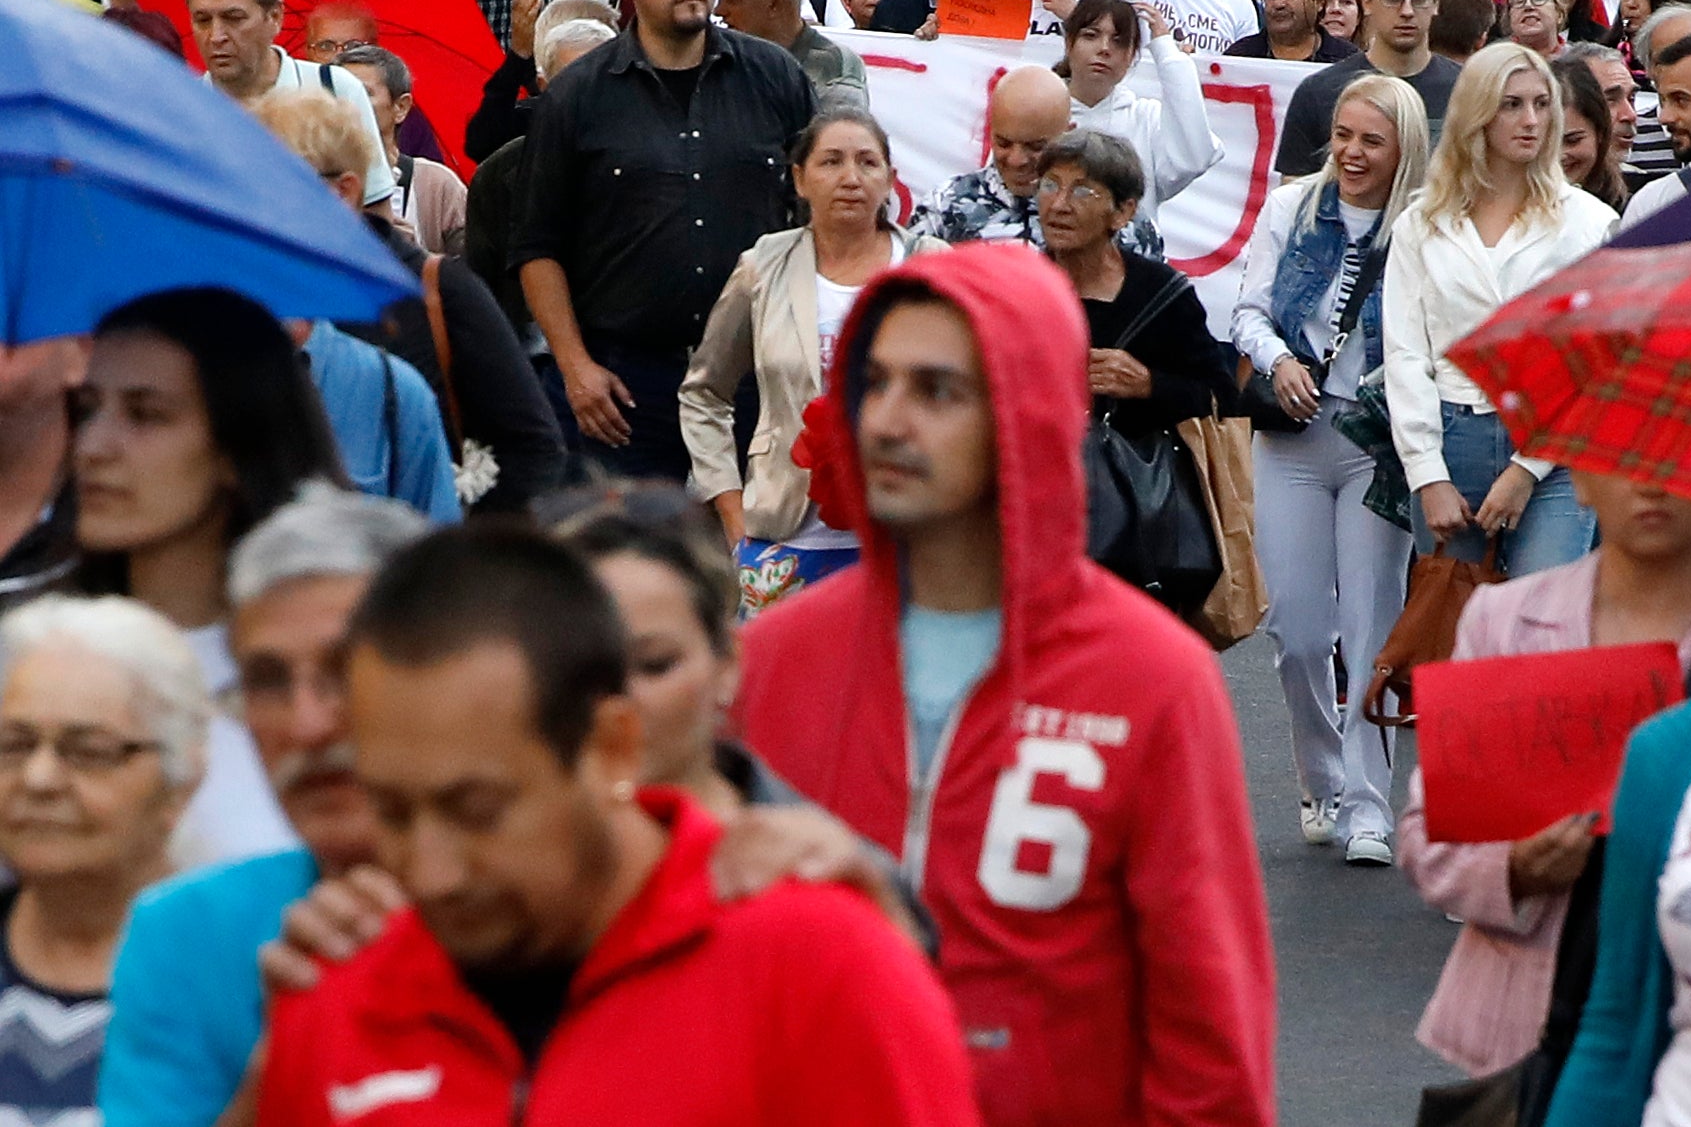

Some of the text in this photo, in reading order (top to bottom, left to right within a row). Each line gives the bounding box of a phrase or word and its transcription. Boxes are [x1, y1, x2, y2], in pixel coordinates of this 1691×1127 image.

[1030, 20, 1062, 35] LA
[1188, 13, 1219, 31] СМЕ
[976, 736, 1107, 912] 6
